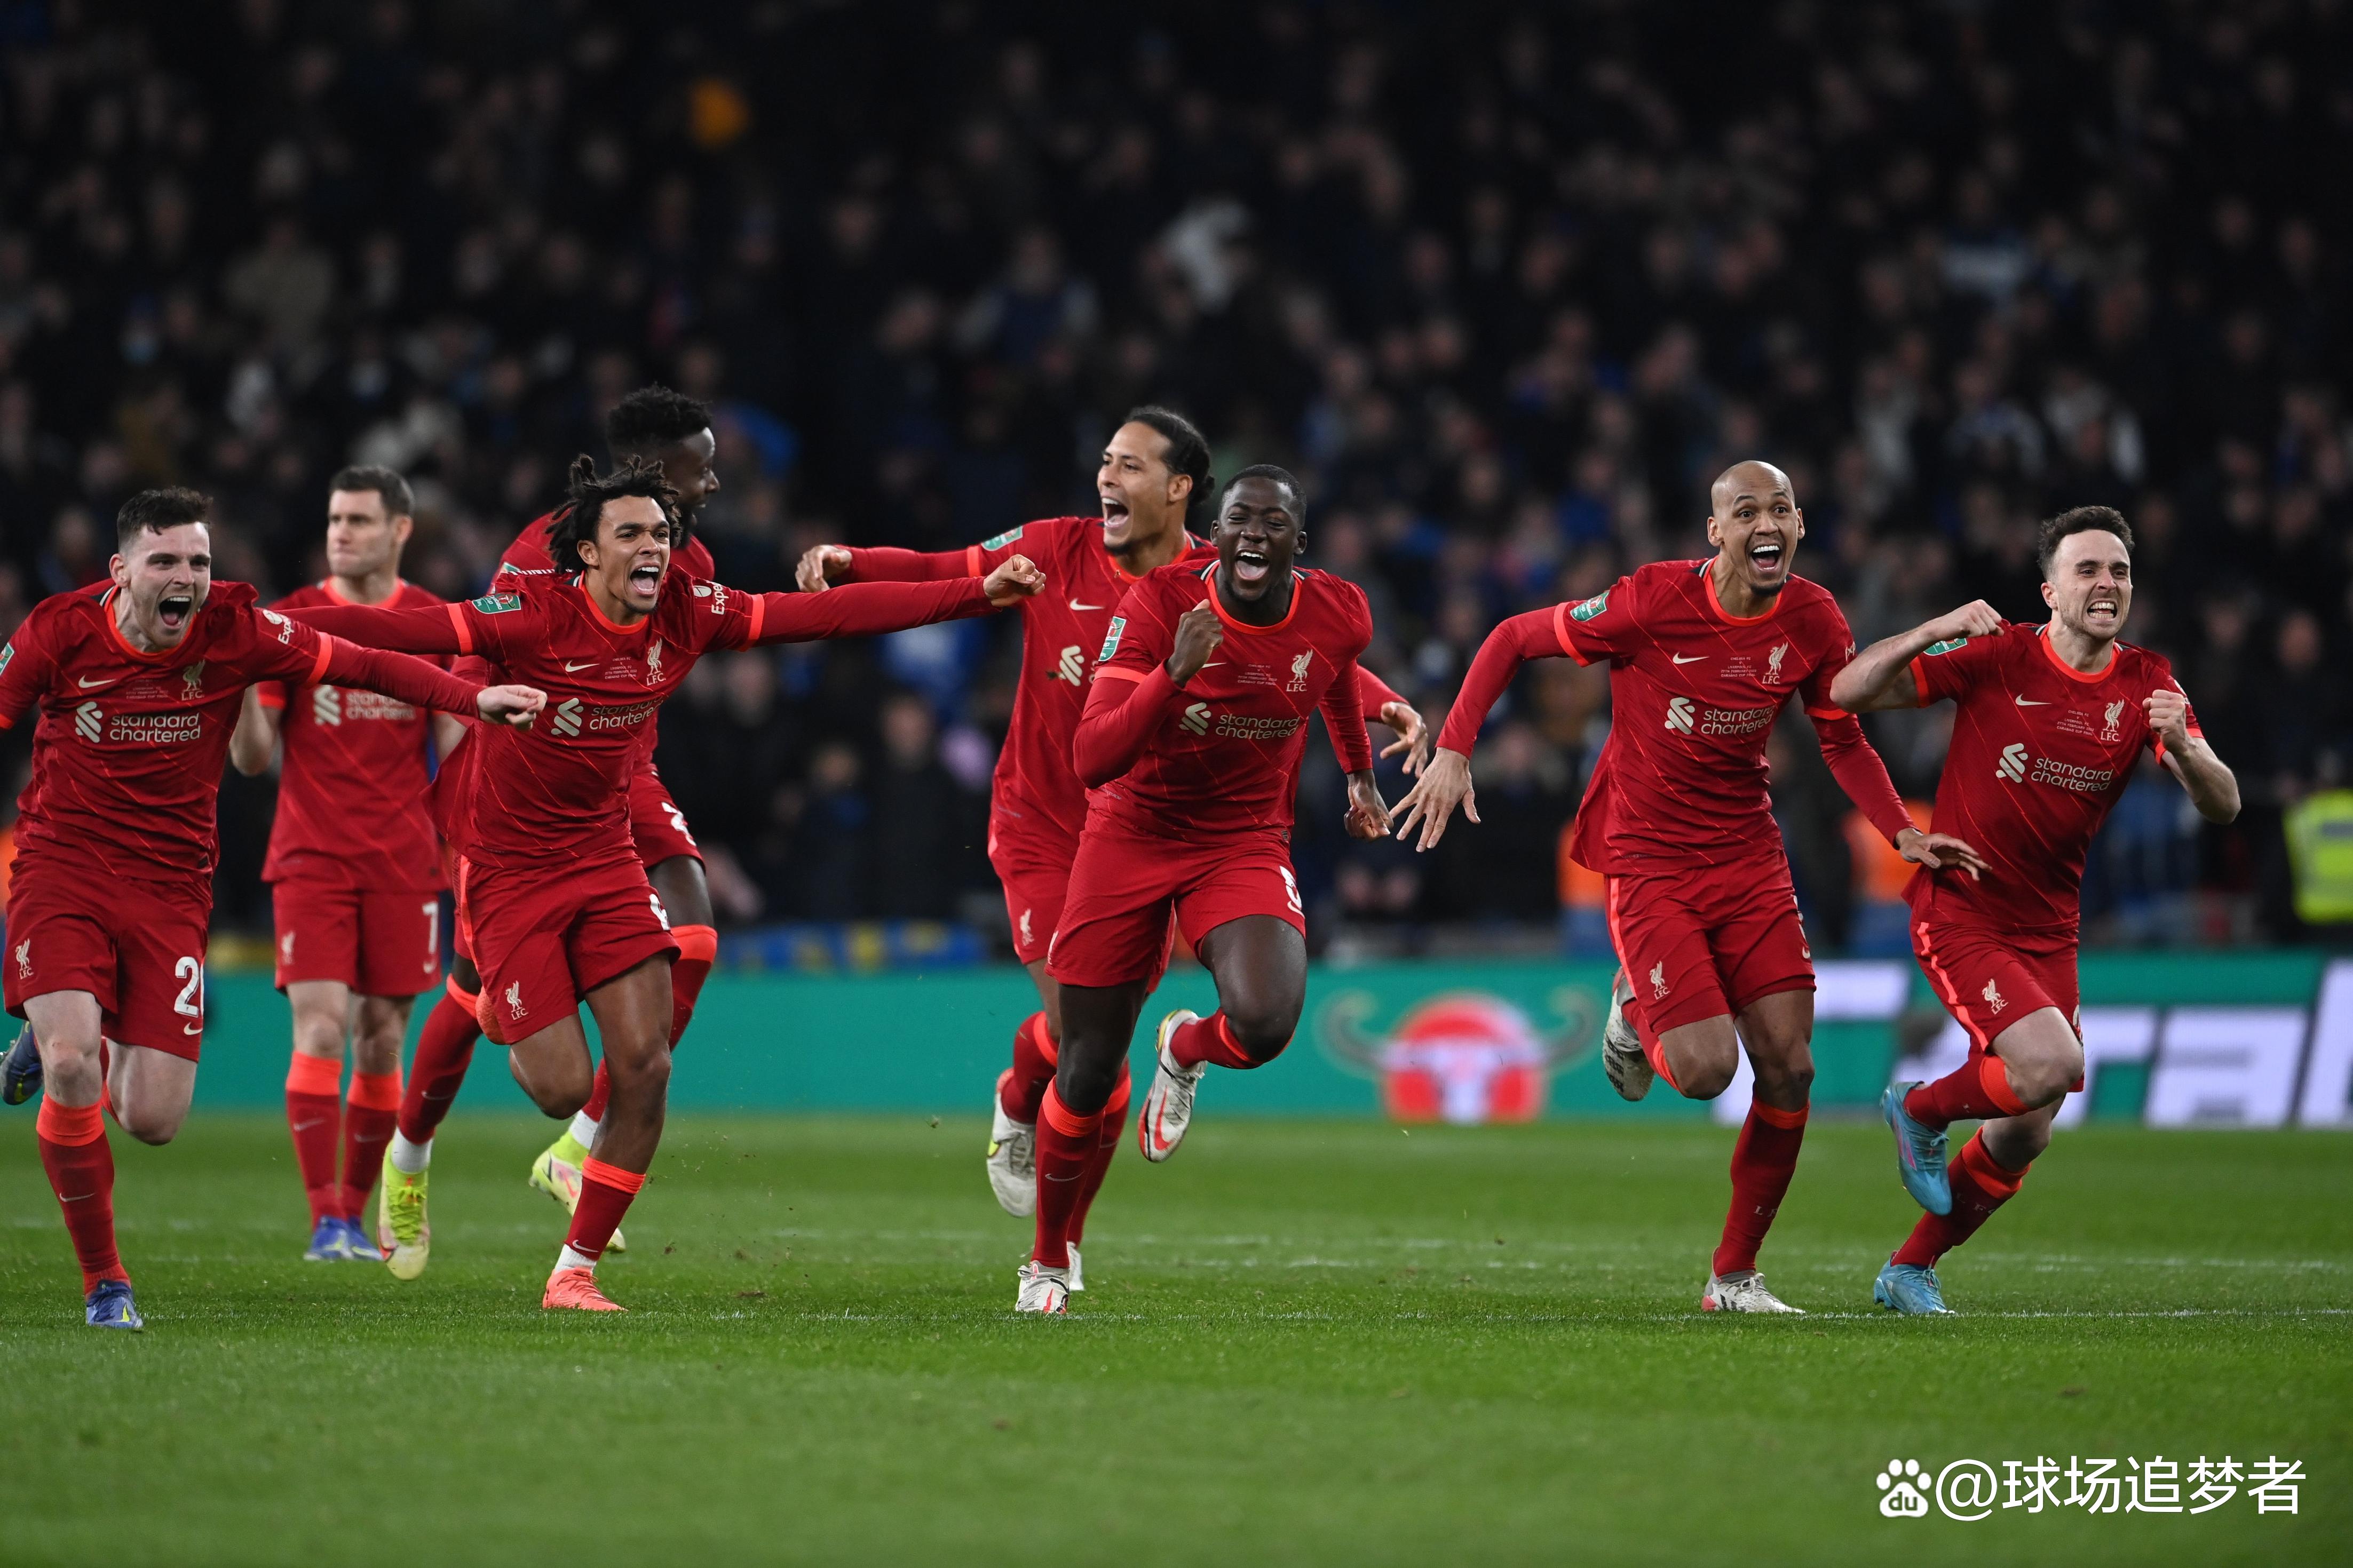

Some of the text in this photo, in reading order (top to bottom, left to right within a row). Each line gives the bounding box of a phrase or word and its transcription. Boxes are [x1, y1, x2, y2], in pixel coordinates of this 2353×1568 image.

[111, 713, 200, 728] standard
[1218, 713, 1301, 728] standard
[1701, 711, 1774, 735] chartered
[110, 726, 201, 743] chartered
[1215, 725, 1299, 739] chartered
[2034, 758, 2113, 781] standard
[2031, 770, 2111, 792] chartered
[422, 901, 438, 954] 7
[173, 956, 204, 1018] 2
